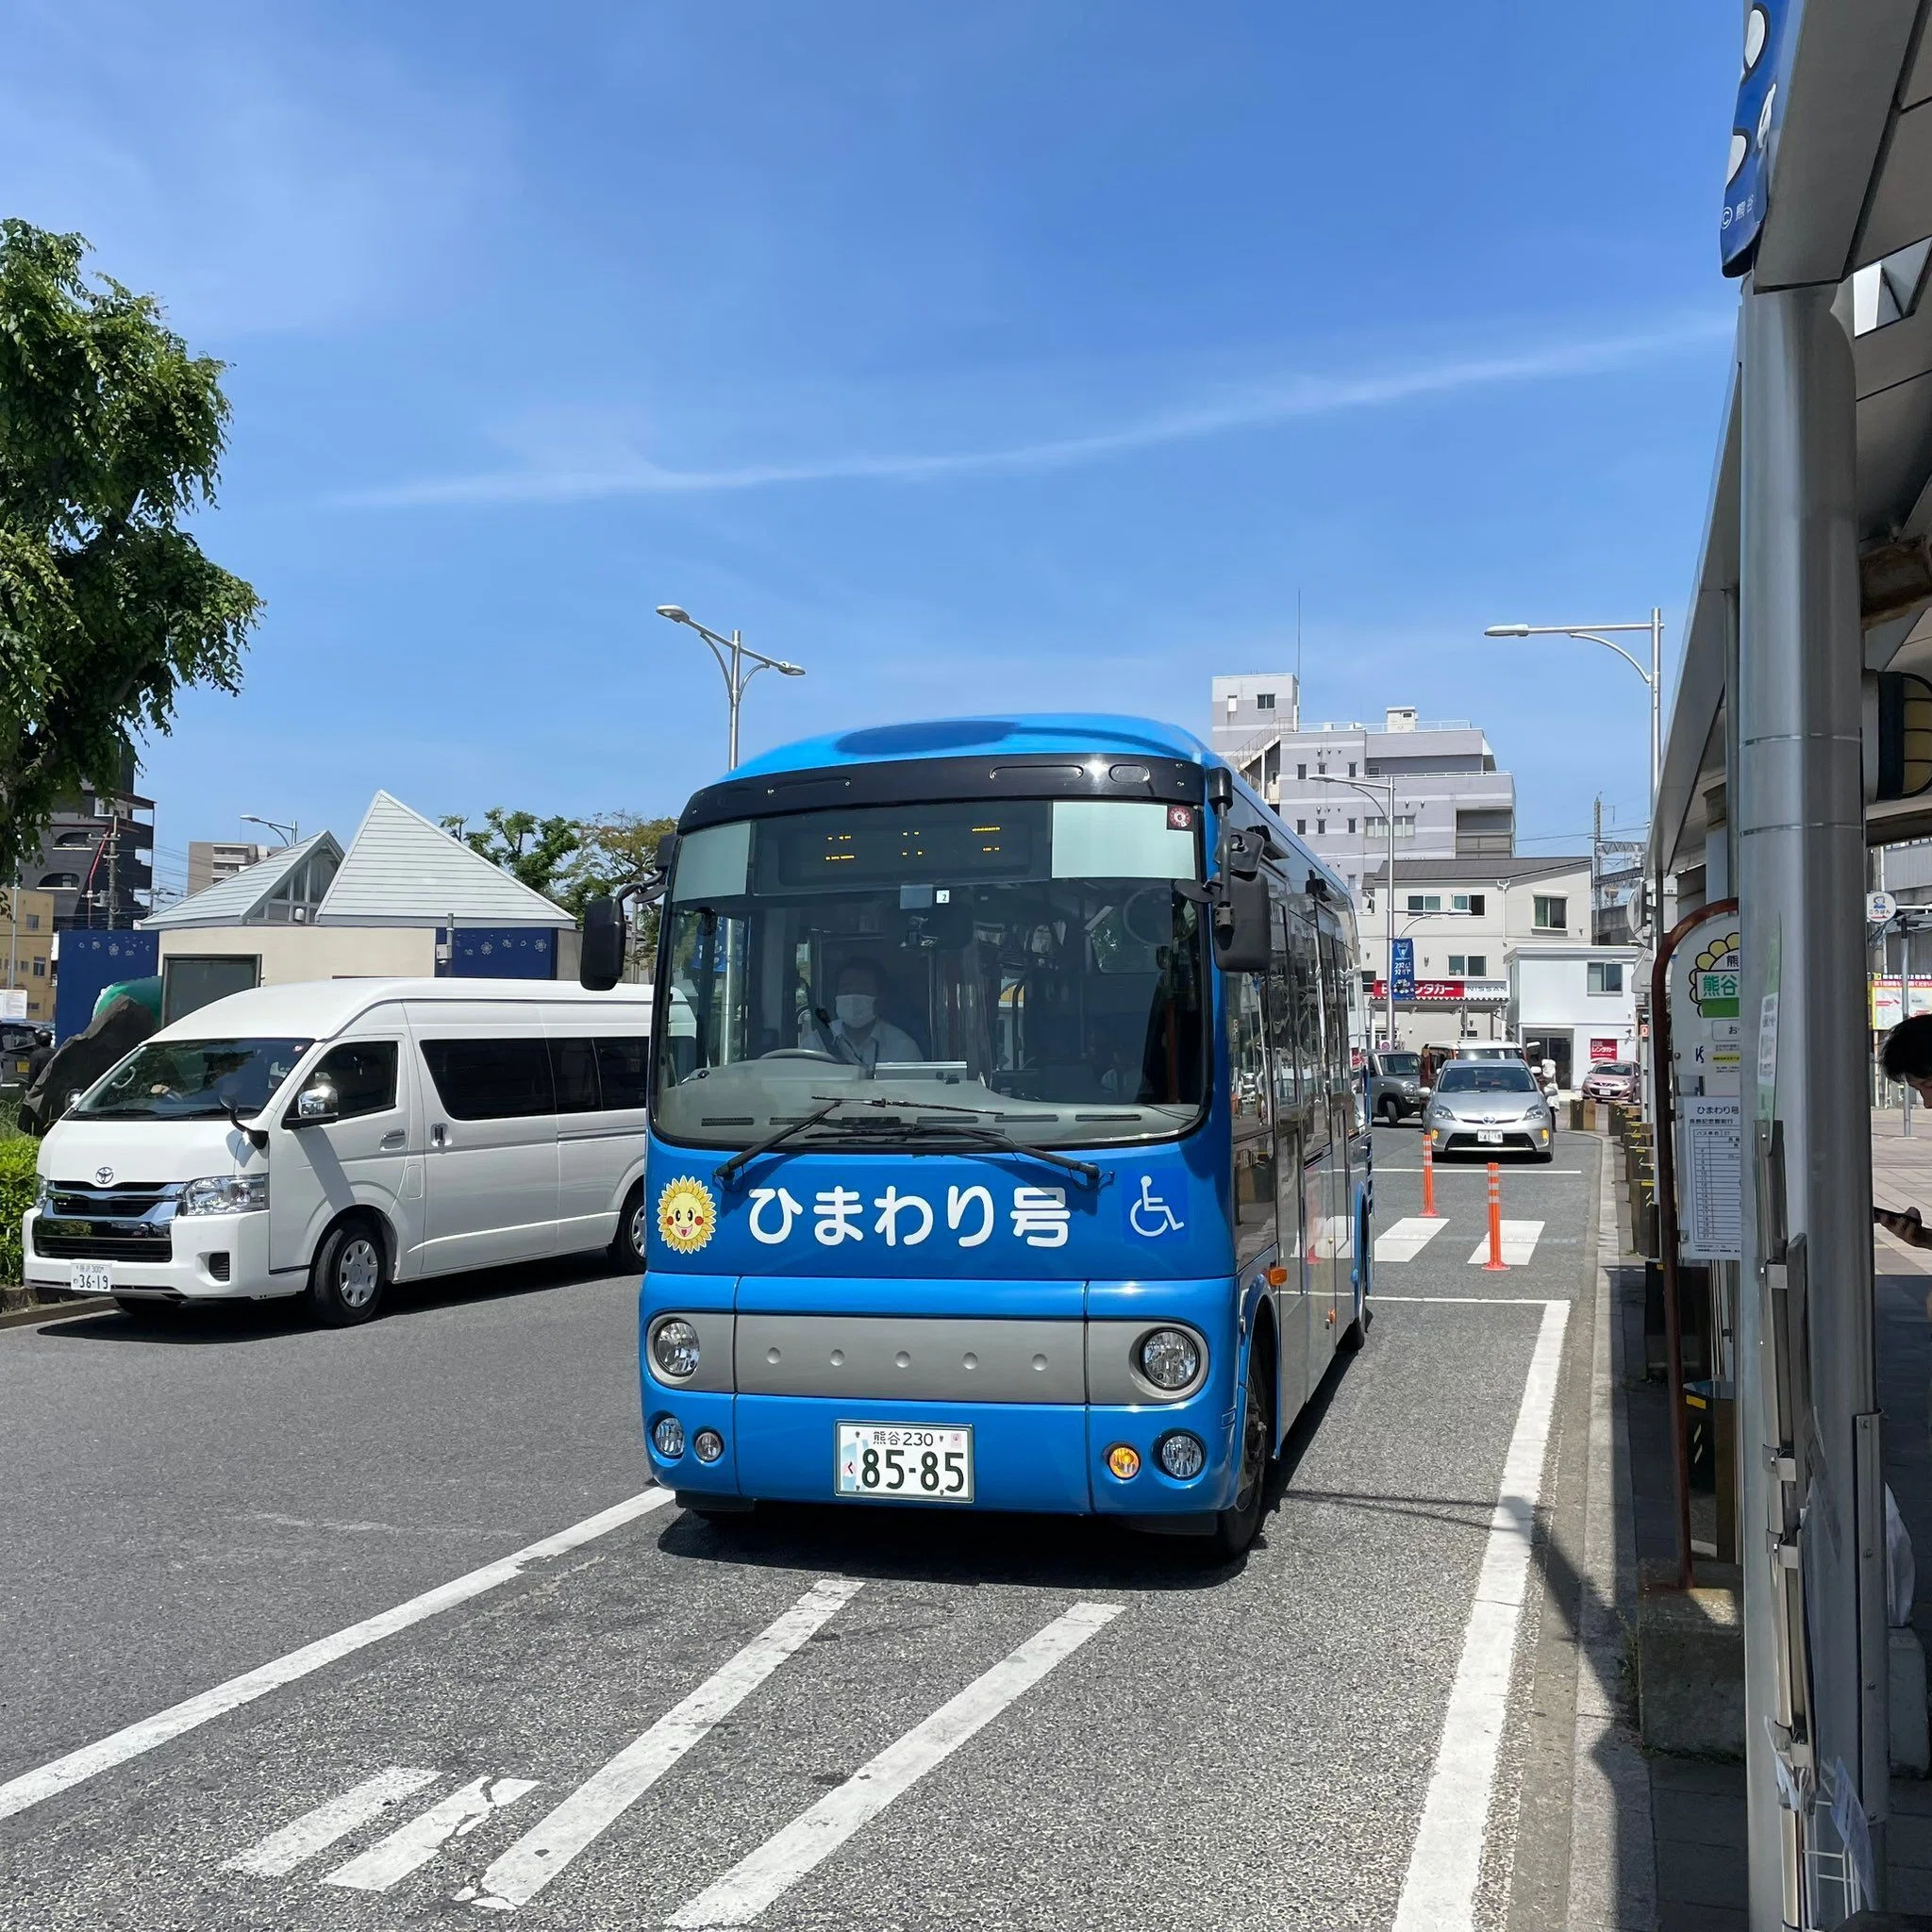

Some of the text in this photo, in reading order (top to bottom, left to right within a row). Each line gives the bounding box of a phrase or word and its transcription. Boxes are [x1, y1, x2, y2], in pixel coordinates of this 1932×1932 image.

[1703, 974, 1738, 997] 熊谷
[1697, 1106, 1740, 1114] ひまわり号
[748, 1185, 1072, 1247] ひまわり号
[79, 1274, 108, 1290] 36-19
[873, 1430, 934, 1447] 熊谷230
[861, 1448, 964, 1492] 85-85
